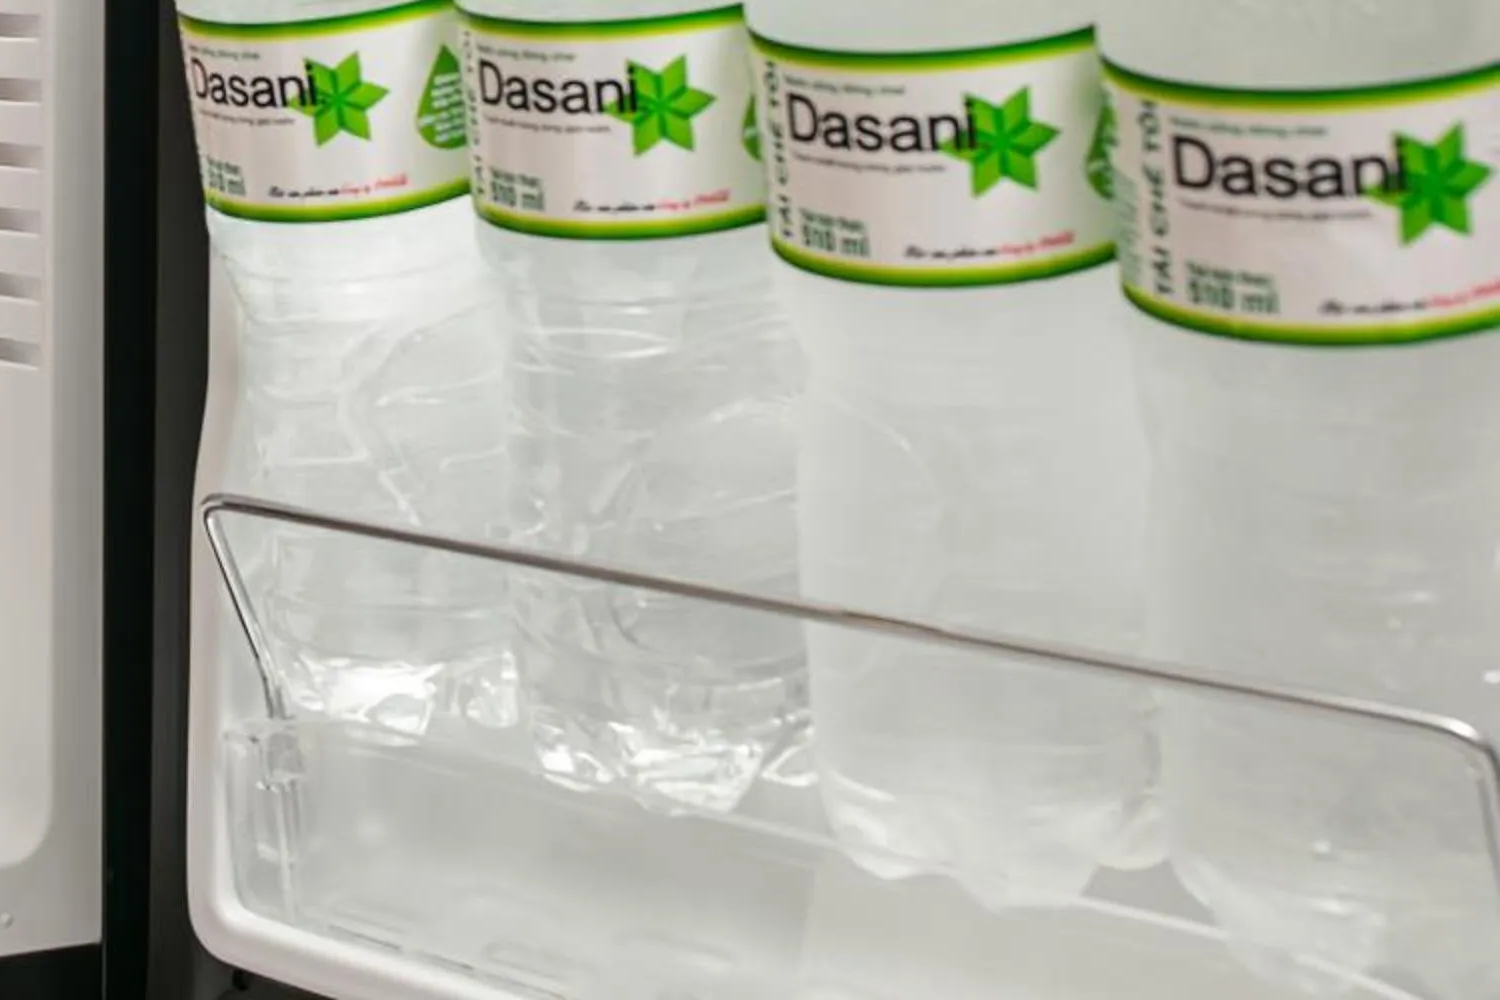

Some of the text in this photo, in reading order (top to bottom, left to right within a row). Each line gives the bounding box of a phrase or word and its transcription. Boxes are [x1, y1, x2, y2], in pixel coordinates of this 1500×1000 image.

[190, 57, 317, 108] Dasani
[479, 58, 637, 114] Dasani
[787, 92, 978, 152] Dasani
[1171, 135, 1408, 199] Dasani
